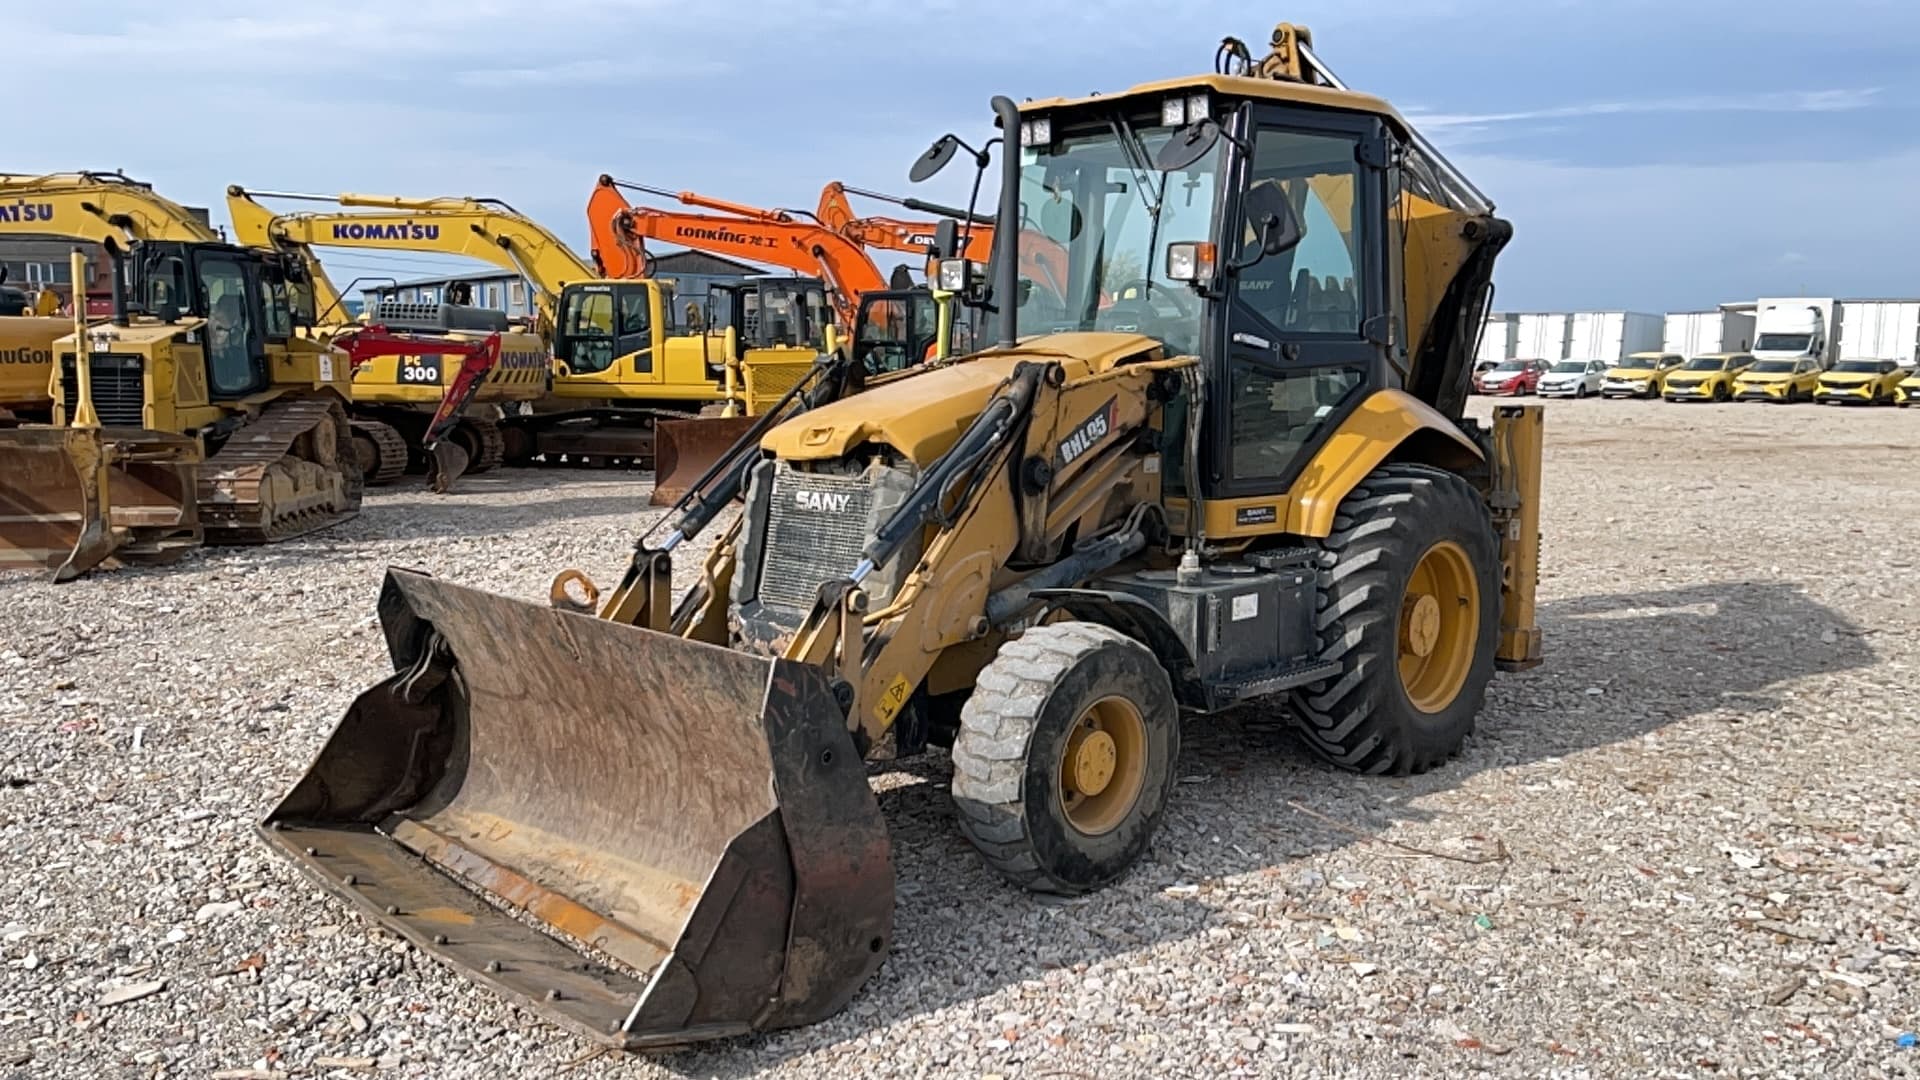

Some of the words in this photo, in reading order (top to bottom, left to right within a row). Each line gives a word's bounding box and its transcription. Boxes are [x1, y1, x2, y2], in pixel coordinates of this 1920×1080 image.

[332, 219, 440, 240] KOMATSU
[1239, 280, 1274, 290] SANY
[404, 355, 421, 366] PC
[404, 367, 438, 381] 300
[796, 490, 850, 513] SANY
